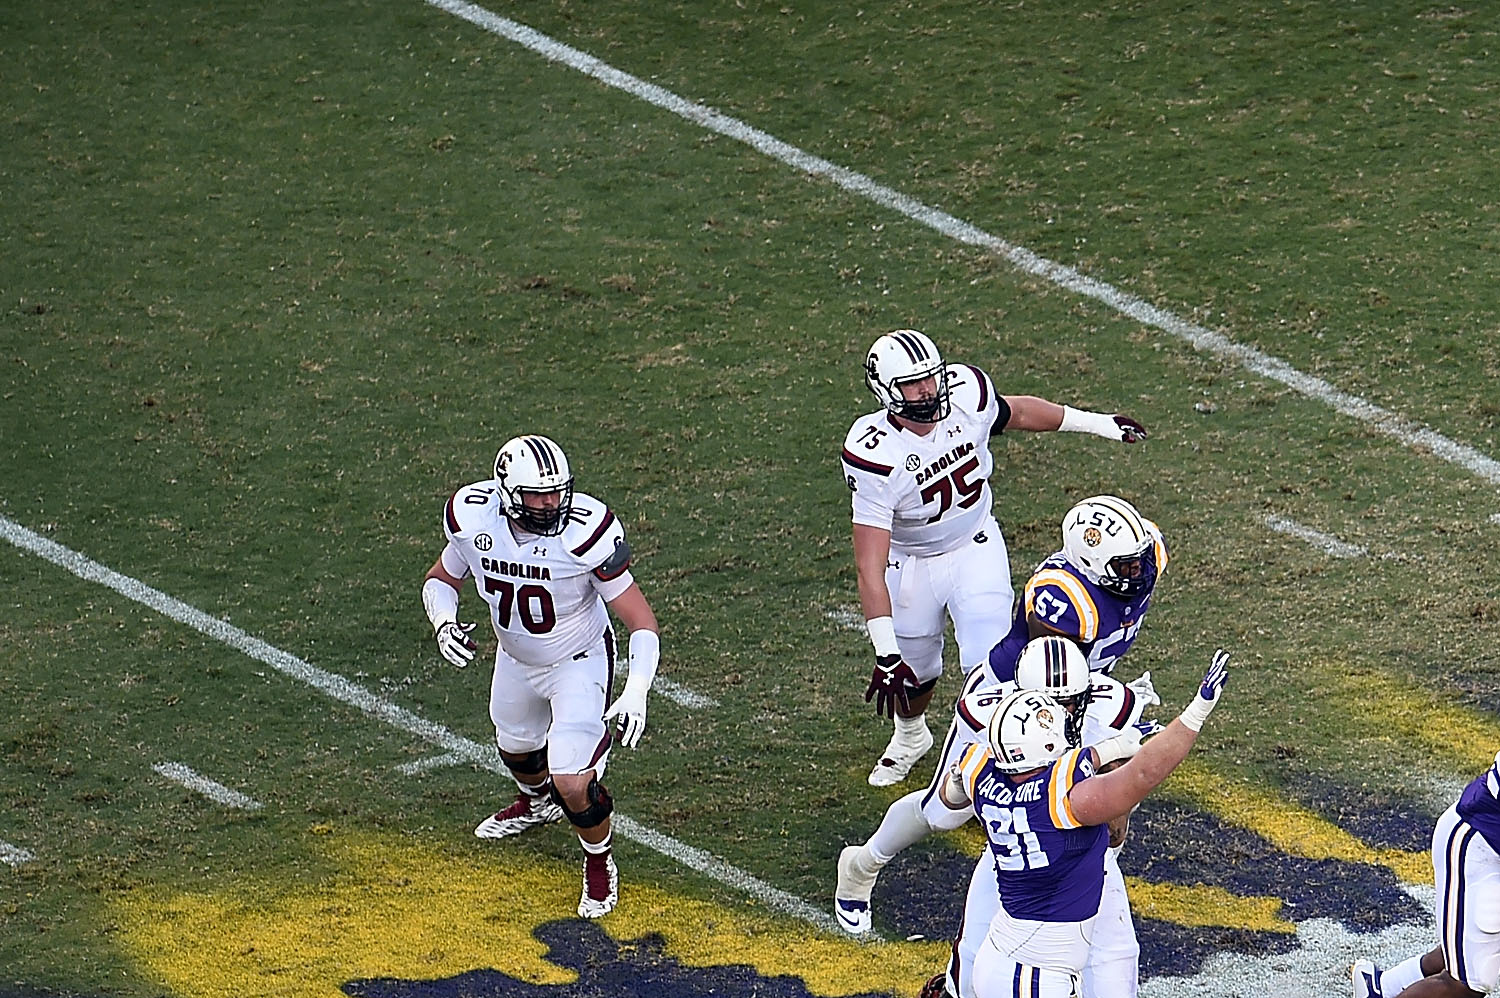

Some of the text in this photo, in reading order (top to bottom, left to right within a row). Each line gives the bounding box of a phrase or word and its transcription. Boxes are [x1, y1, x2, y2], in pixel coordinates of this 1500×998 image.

[856, 425, 888, 450] 75
[915, 442, 975, 486] CAROLINA
[464, 487, 496, 505] 70
[920, 455, 986, 525] 75
[1069, 511, 1122, 538] LSU
[480, 557, 552, 581] CAROLINA
[484, 575, 557, 635] 70
[977, 772, 1045, 805] LACOURE
[981, 804, 1050, 871] 91
